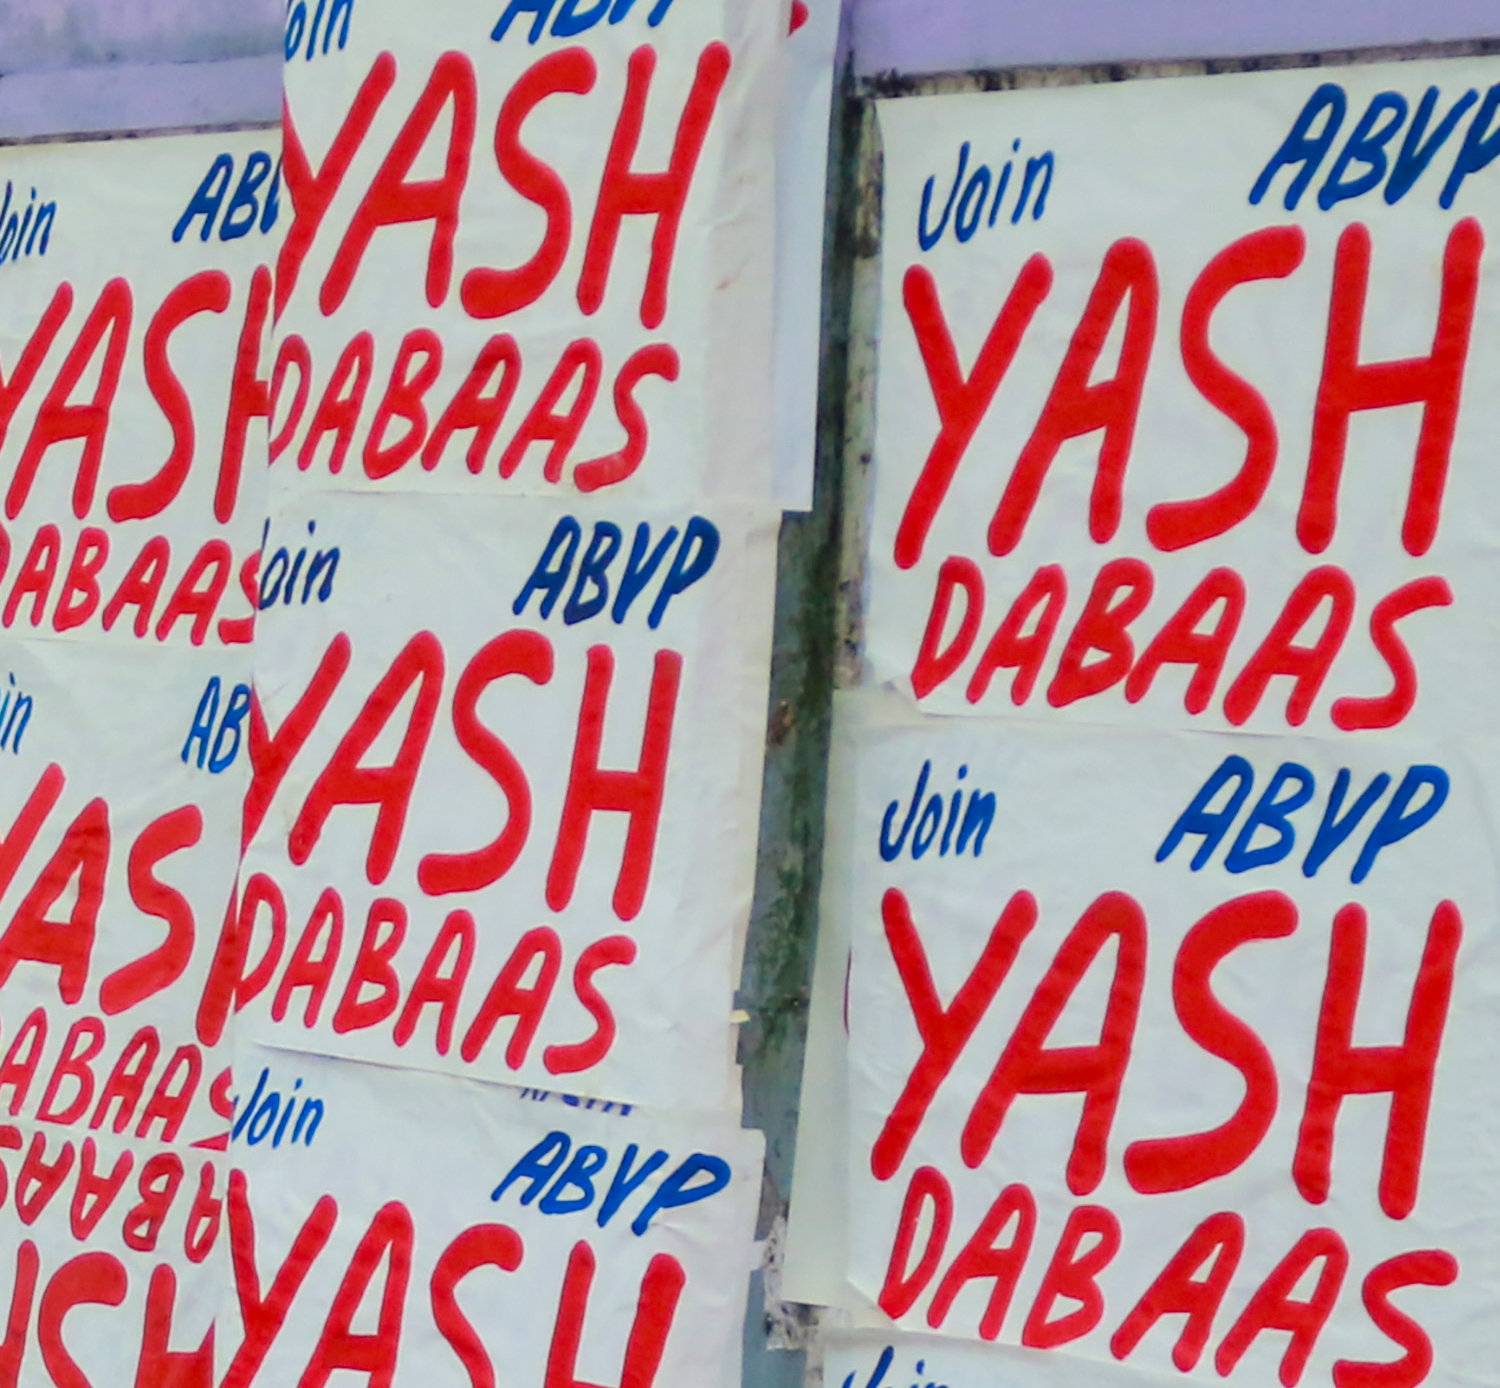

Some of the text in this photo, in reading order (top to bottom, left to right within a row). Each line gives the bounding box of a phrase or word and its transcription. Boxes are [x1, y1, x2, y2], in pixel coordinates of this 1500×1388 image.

[274, 40, 731, 331] YASH
[917, 137, 1055, 251] Join
[268, 328, 680, 493] DABAAS
[893, 217, 1484, 568] YASH
[512, 515, 720, 628] ABVP
[911, 554, 1453, 730] DABAAS
[240, 628, 683, 923] YASH
[878, 754, 1450, 884] Join ABVP
[234, 872, 637, 1076] DABAAS
[871, 885, 1464, 1220] YASH
[491, 1129, 731, 1237] ABVP
